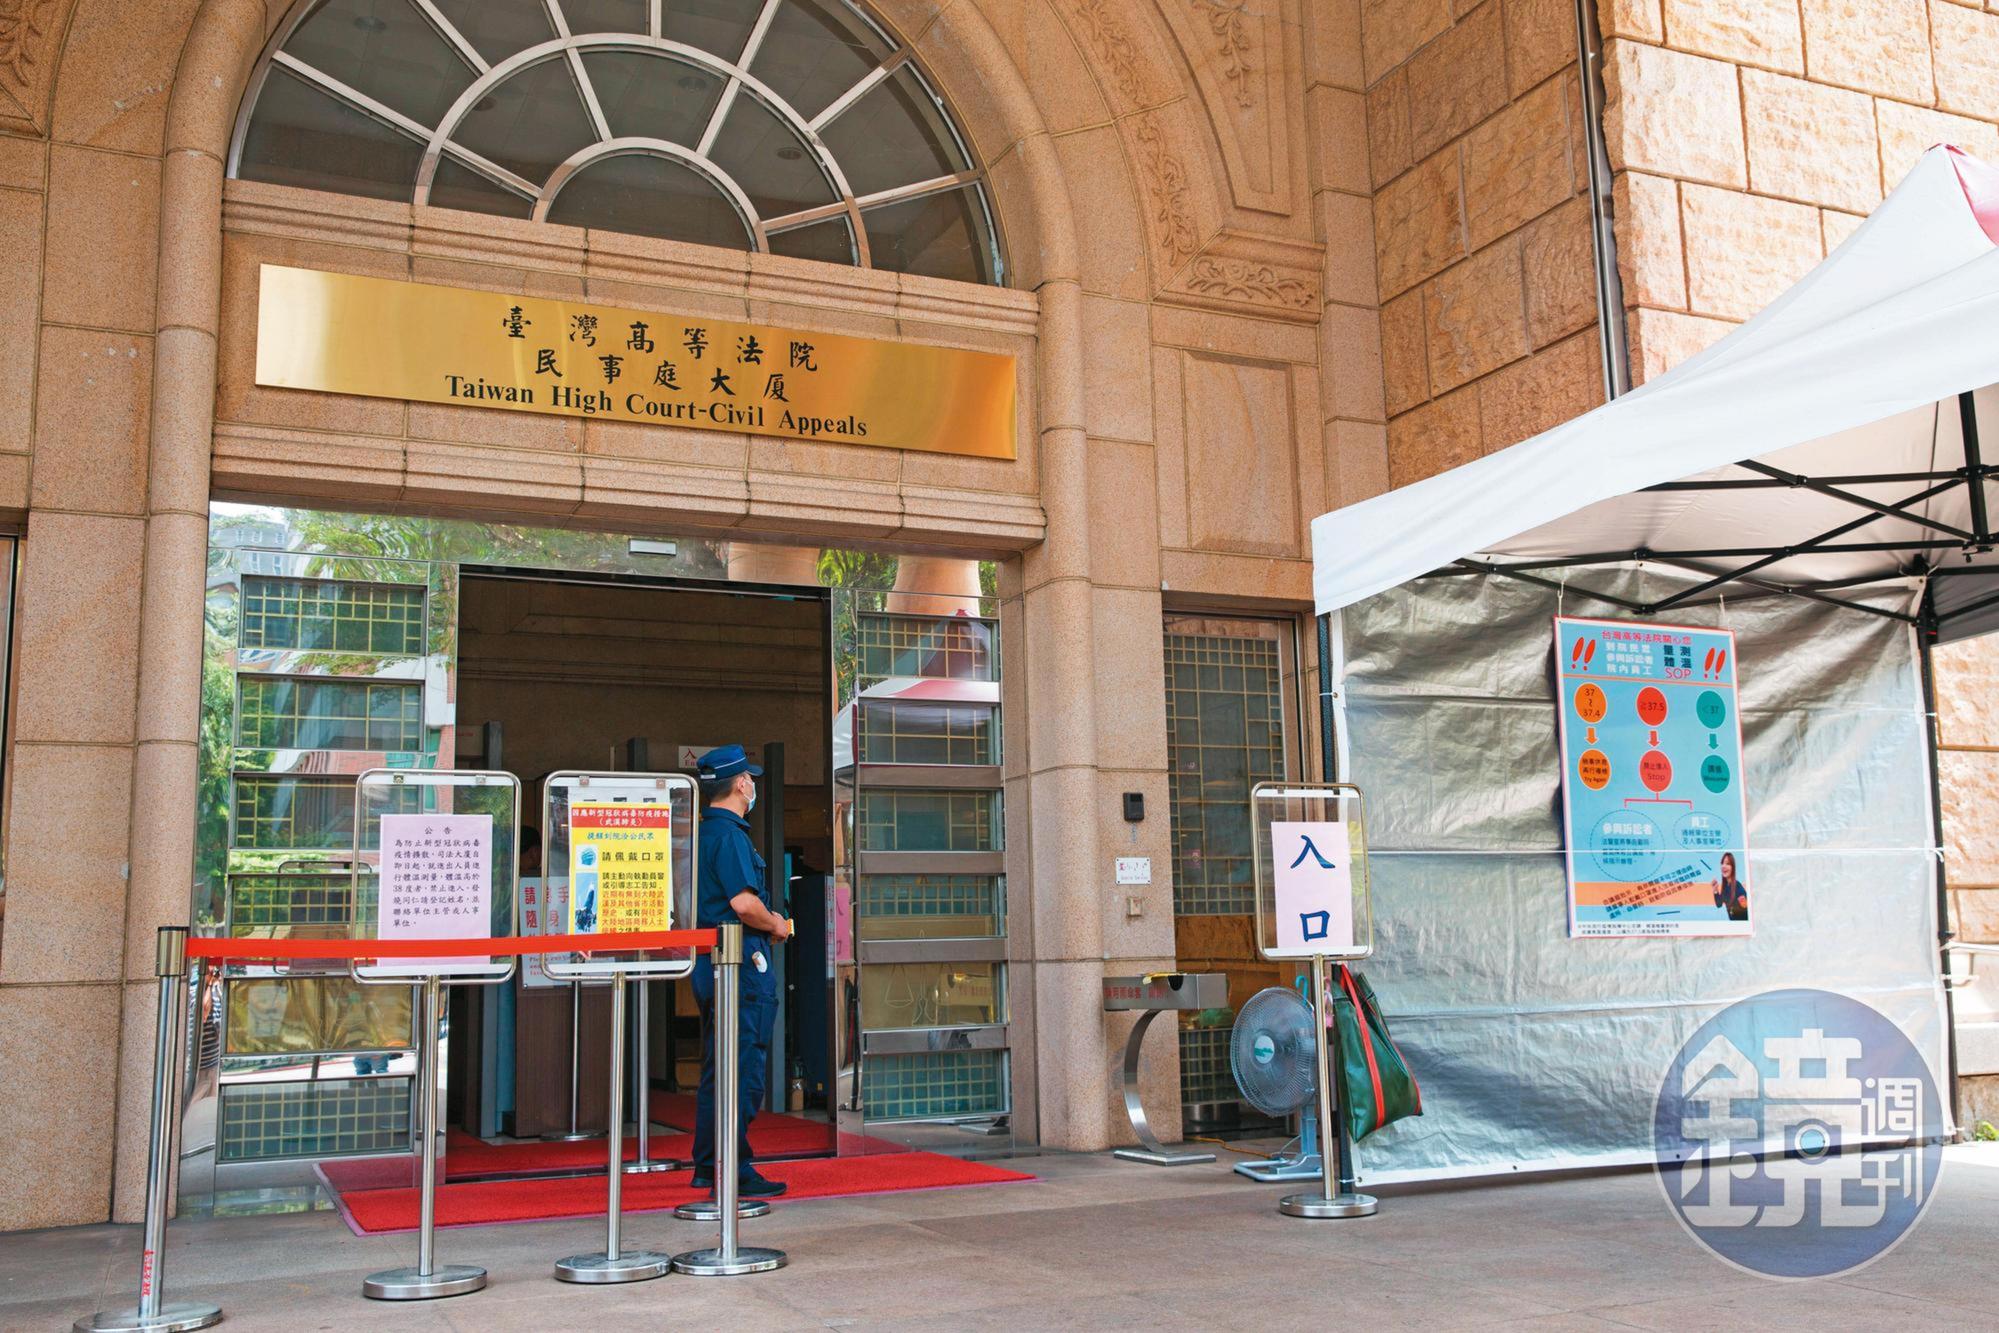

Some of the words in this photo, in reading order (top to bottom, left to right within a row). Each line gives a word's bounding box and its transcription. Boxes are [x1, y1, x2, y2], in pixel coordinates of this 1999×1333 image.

[445, 374, 535, 405] Taiwan
[552, 384, 614, 415] High
[625, 392, 765, 427] Court-Civil
[778, 409, 868, 436] Appeals
[1665, 667, 1693, 680] SOP
[1584, 688, 1595, 697] 37
[1583, 709, 1601, 718] 37.4
[1647, 773, 1666, 782] Stop
[1289, 833, 1337, 943] 入口
